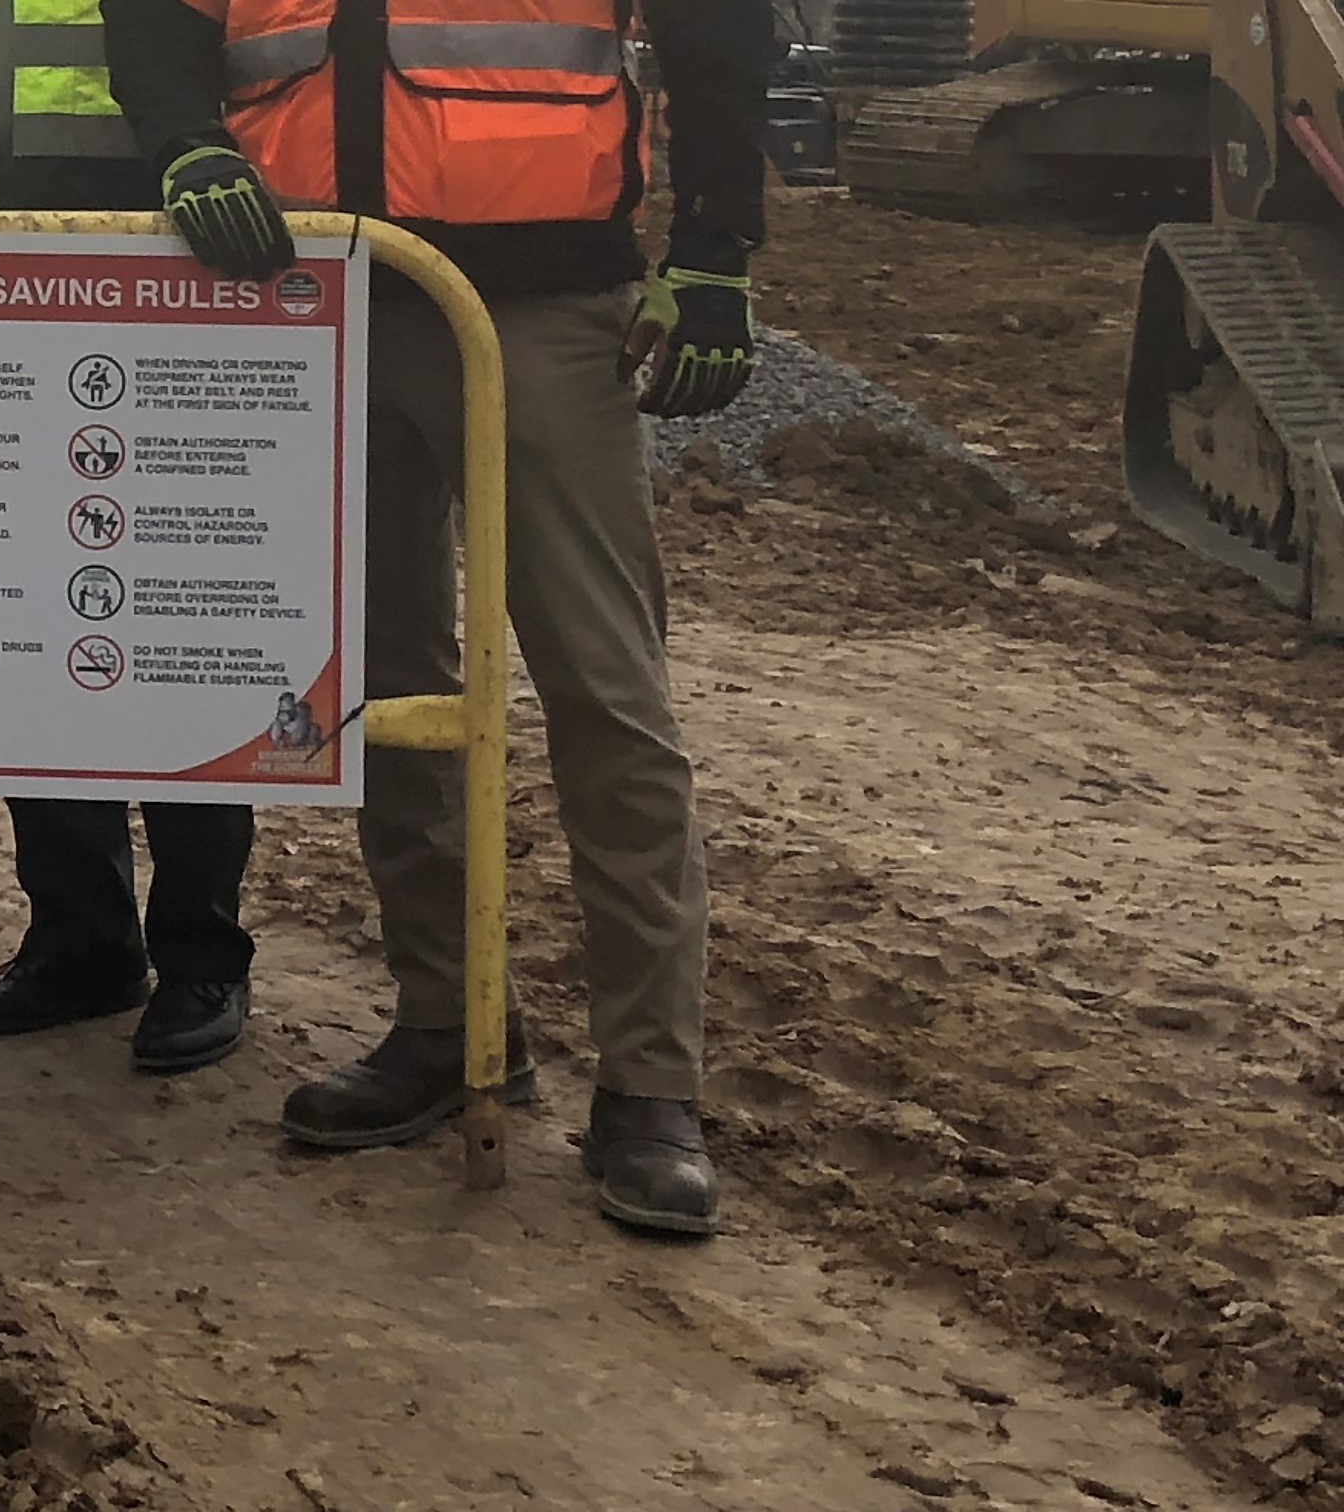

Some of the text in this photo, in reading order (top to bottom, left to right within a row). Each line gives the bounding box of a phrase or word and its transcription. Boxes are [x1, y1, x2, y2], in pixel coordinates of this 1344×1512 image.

[136, 279, 261, 309] RULES
[135, 358, 169, 368] WHEN
[173, 359, 218, 369] DRIVING
[241, 360, 307, 371] OPERATING
[0, 376, 35, 386] WHEN
[209, 373, 256, 383] ALWAYS
[260, 373, 295, 384] WEAR
[135, 386, 168, 395] YOUR
[172, 387, 201, 396] SEAT
[240, 388, 263, 397] AND
[267, 388, 299, 398] REST
[135, 399, 150, 409] AT
[152, 400, 174, 409] THE
[177, 400, 209, 410] FIRST
[213, 400, 240, 410] SIGN
[243, 401, 259, 410] OF
[135, 437, 277, 449] OBTAIN AUTHORIZATION
[135, 451, 246, 462] BEFORE ENTERING
[135, 464, 142, 473] A
[146, 464, 206, 475] CONFINED
[134, 507, 182, 516] ALWAYS
[185, 508, 235, 517] ISOLATE
[134, 520, 268, 532] CONTROL HAZARDOUS
[134, 534, 191, 543] SOURCES
[194, 534, 210, 544] OF
[134, 579, 275, 591] OBTAIN AUTHORIZATION
[134, 592, 182, 602] BEFORE
[185, 593, 258, 604] OVERRIDING
[134, 606, 197, 616] DISABLING
[200, 607, 208, 617] A
[212, 608, 255, 618] SAFETY
[2, 642, 42, 652] DRUGS
[134, 646, 263, 658] DO NOT SMOKE WHEN
[134, 659, 200, 670] REFUELING
[224, 662, 285, 672] HANDLING
[134, 673, 206, 684] FLAMMABLE
